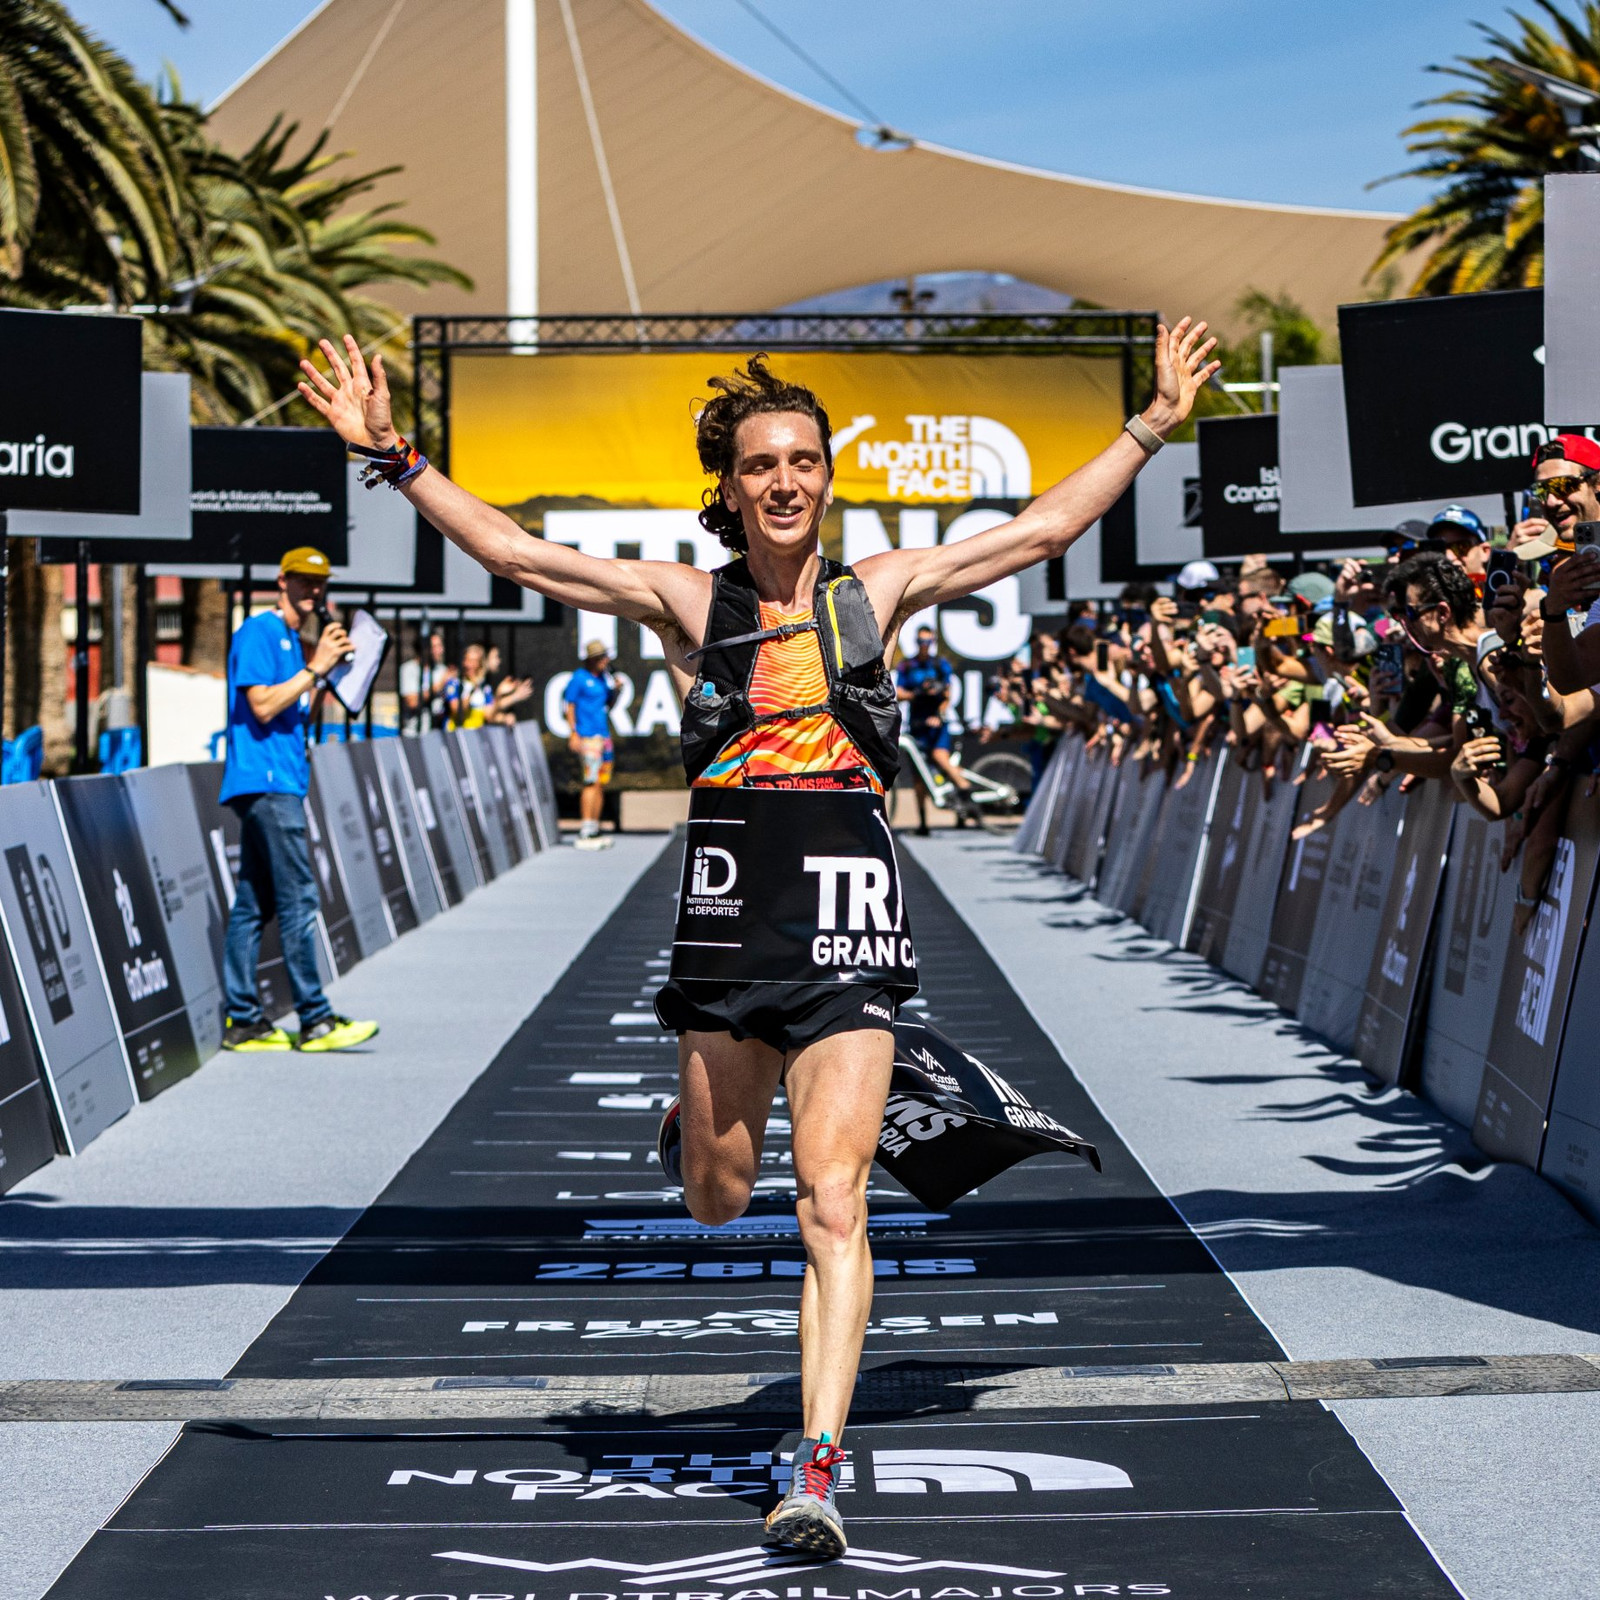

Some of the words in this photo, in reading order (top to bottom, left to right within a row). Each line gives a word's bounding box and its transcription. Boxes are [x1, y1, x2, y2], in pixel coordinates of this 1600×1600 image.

[905, 414, 968, 442] THE
[0, 433, 74, 478] aria
[858, 440, 968, 469] NORTH
[888, 467, 969, 497] FACE
[695, 906, 740, 917] DEPORTES
[812, 934, 896, 967] GRAN
[863, 1002, 891, 1021] HOKA
